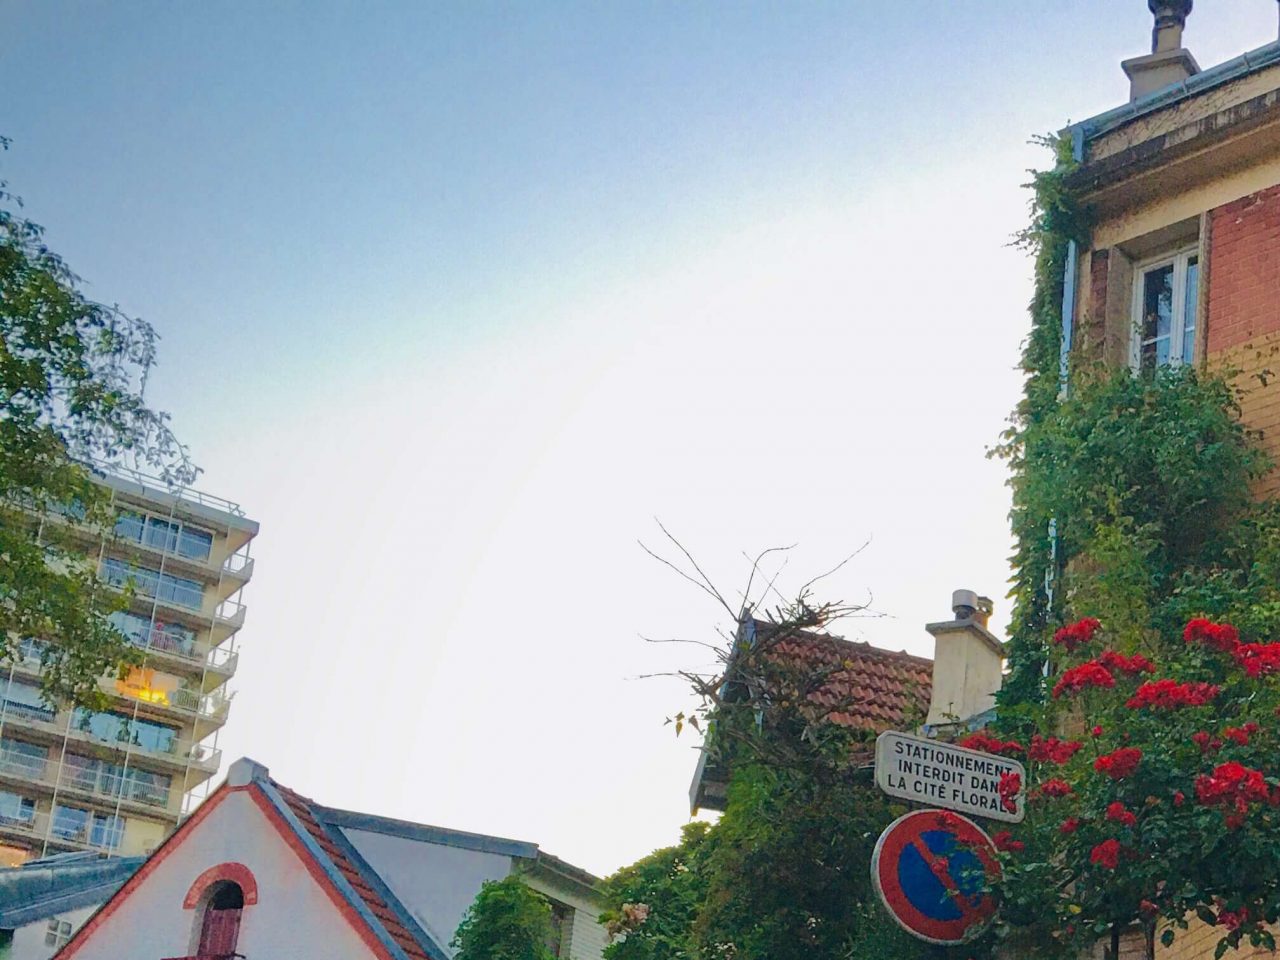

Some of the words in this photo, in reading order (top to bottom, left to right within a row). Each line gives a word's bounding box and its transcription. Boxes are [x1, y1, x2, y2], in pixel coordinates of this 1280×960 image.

[895, 741, 1012, 777] STATIONNEMENT
[898, 759, 964, 786] INTERDIT
[971, 776, 1000, 794] DAN
[888, 774, 907, 791] LA
[913, 779, 946, 799] CITÉ
[952, 789, 1017, 815] FLORAL
